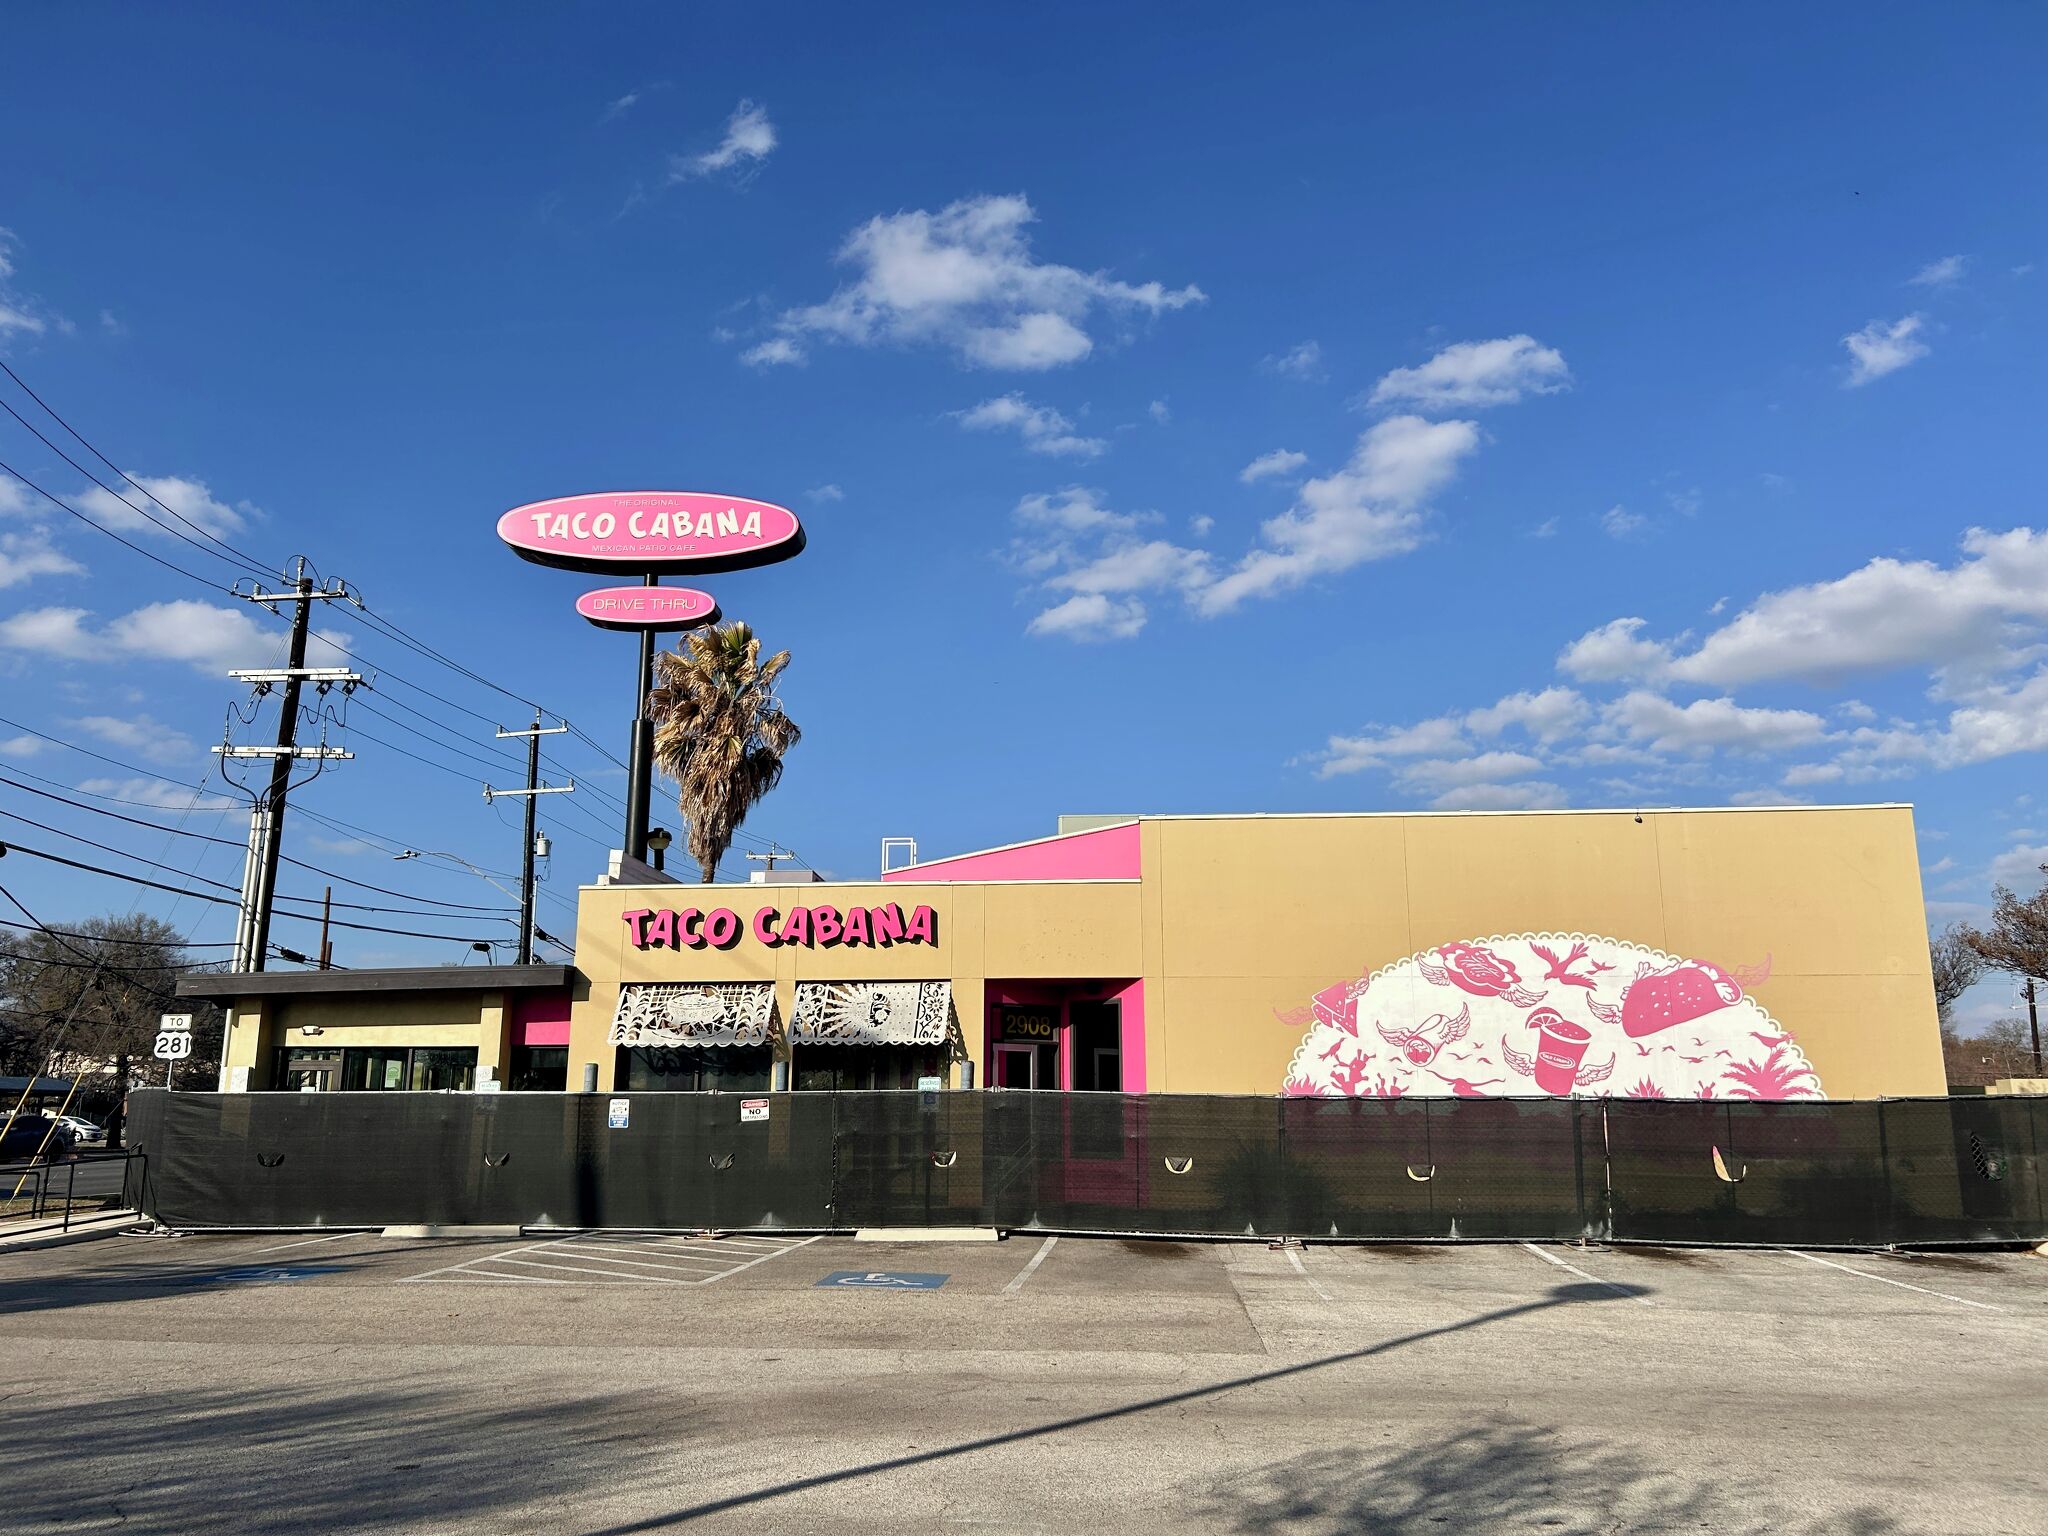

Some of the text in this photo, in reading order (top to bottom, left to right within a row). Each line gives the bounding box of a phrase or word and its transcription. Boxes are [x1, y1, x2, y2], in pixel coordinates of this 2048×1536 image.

[530, 507, 762, 540] TACO CABANA
[593, 598, 698, 610] DRIVE THRU
[622, 902, 938, 950] TACO CABANA
[170, 1017, 183, 1026] TO
[1006, 1014, 1050, 1036] 2908
[156, 1037, 190, 1053] 281
